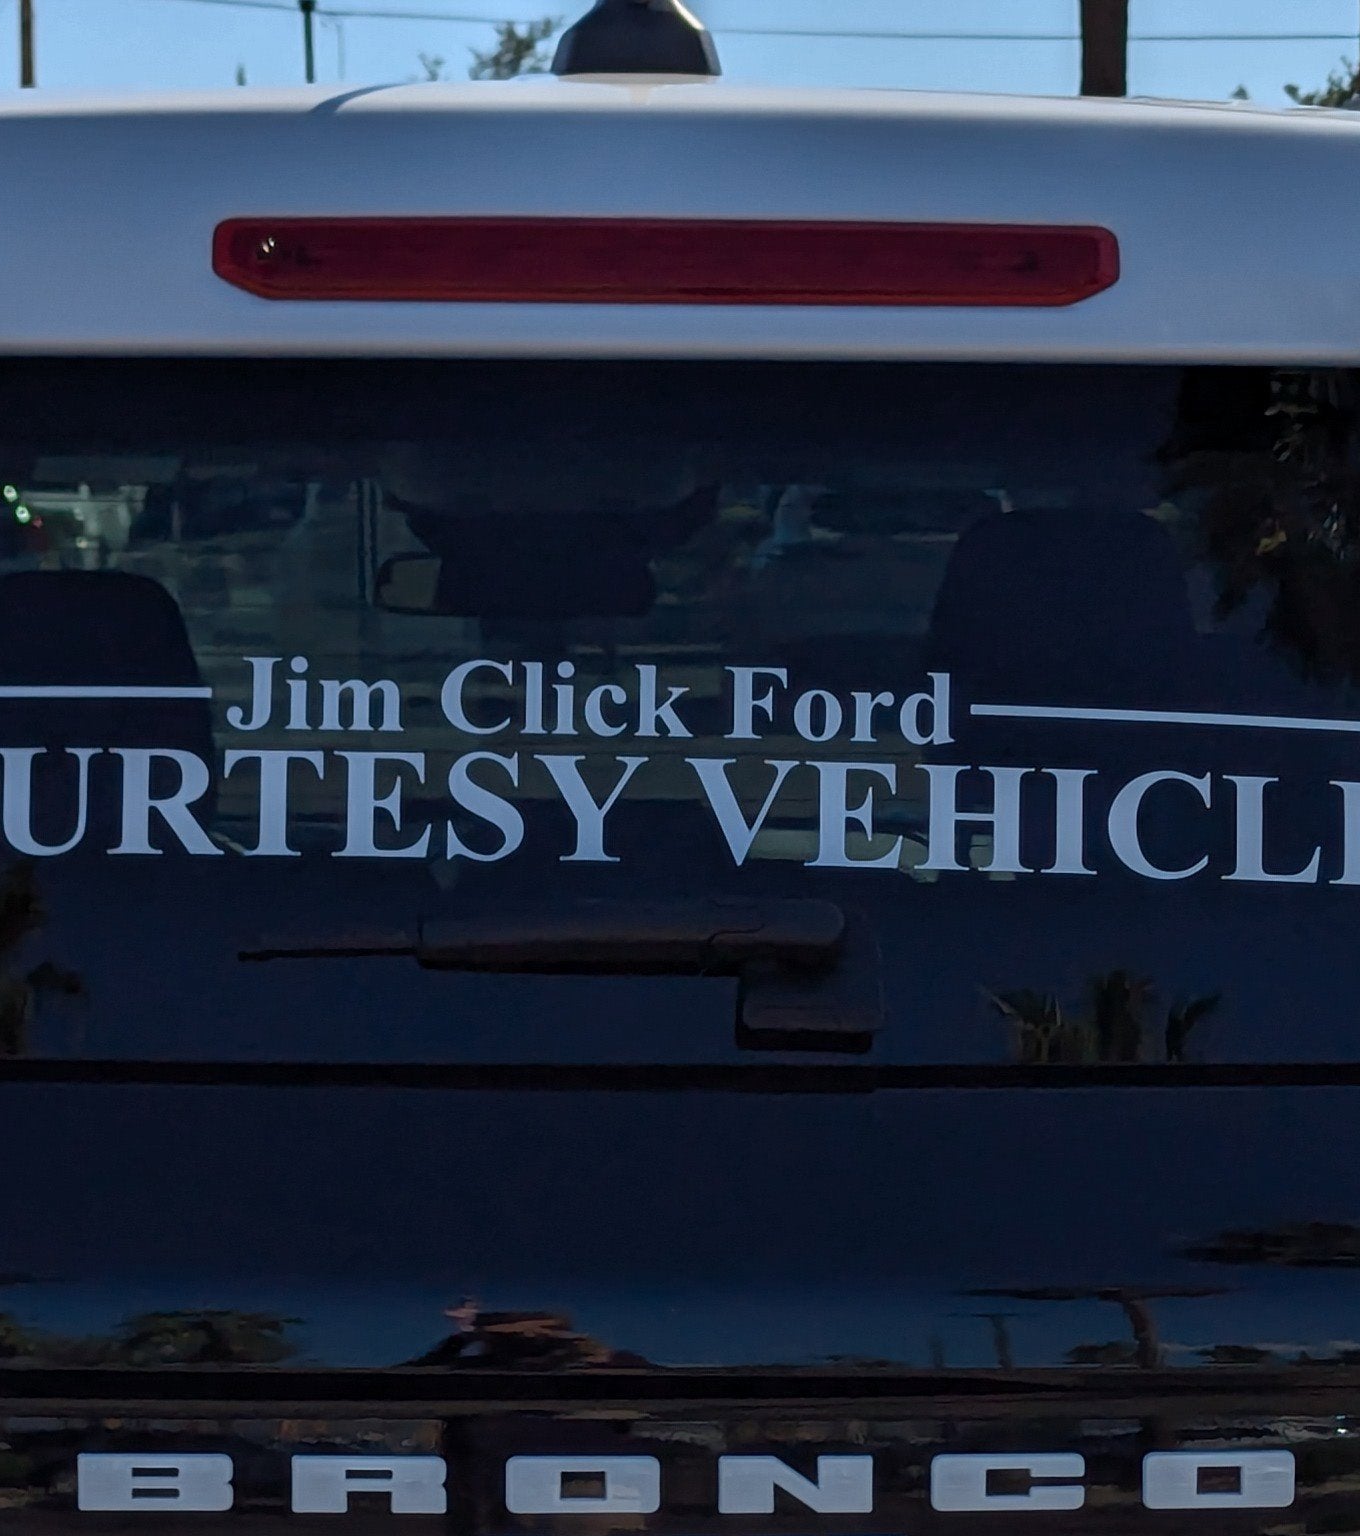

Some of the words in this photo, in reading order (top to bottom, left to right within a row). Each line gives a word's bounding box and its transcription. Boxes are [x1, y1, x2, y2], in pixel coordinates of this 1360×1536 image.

[225, 656, 405, 733] Jim
[440, 659, 694, 740] Click
[723, 665, 956, 746] Ford
[77, 1452, 1297, 1515] BRONCO
